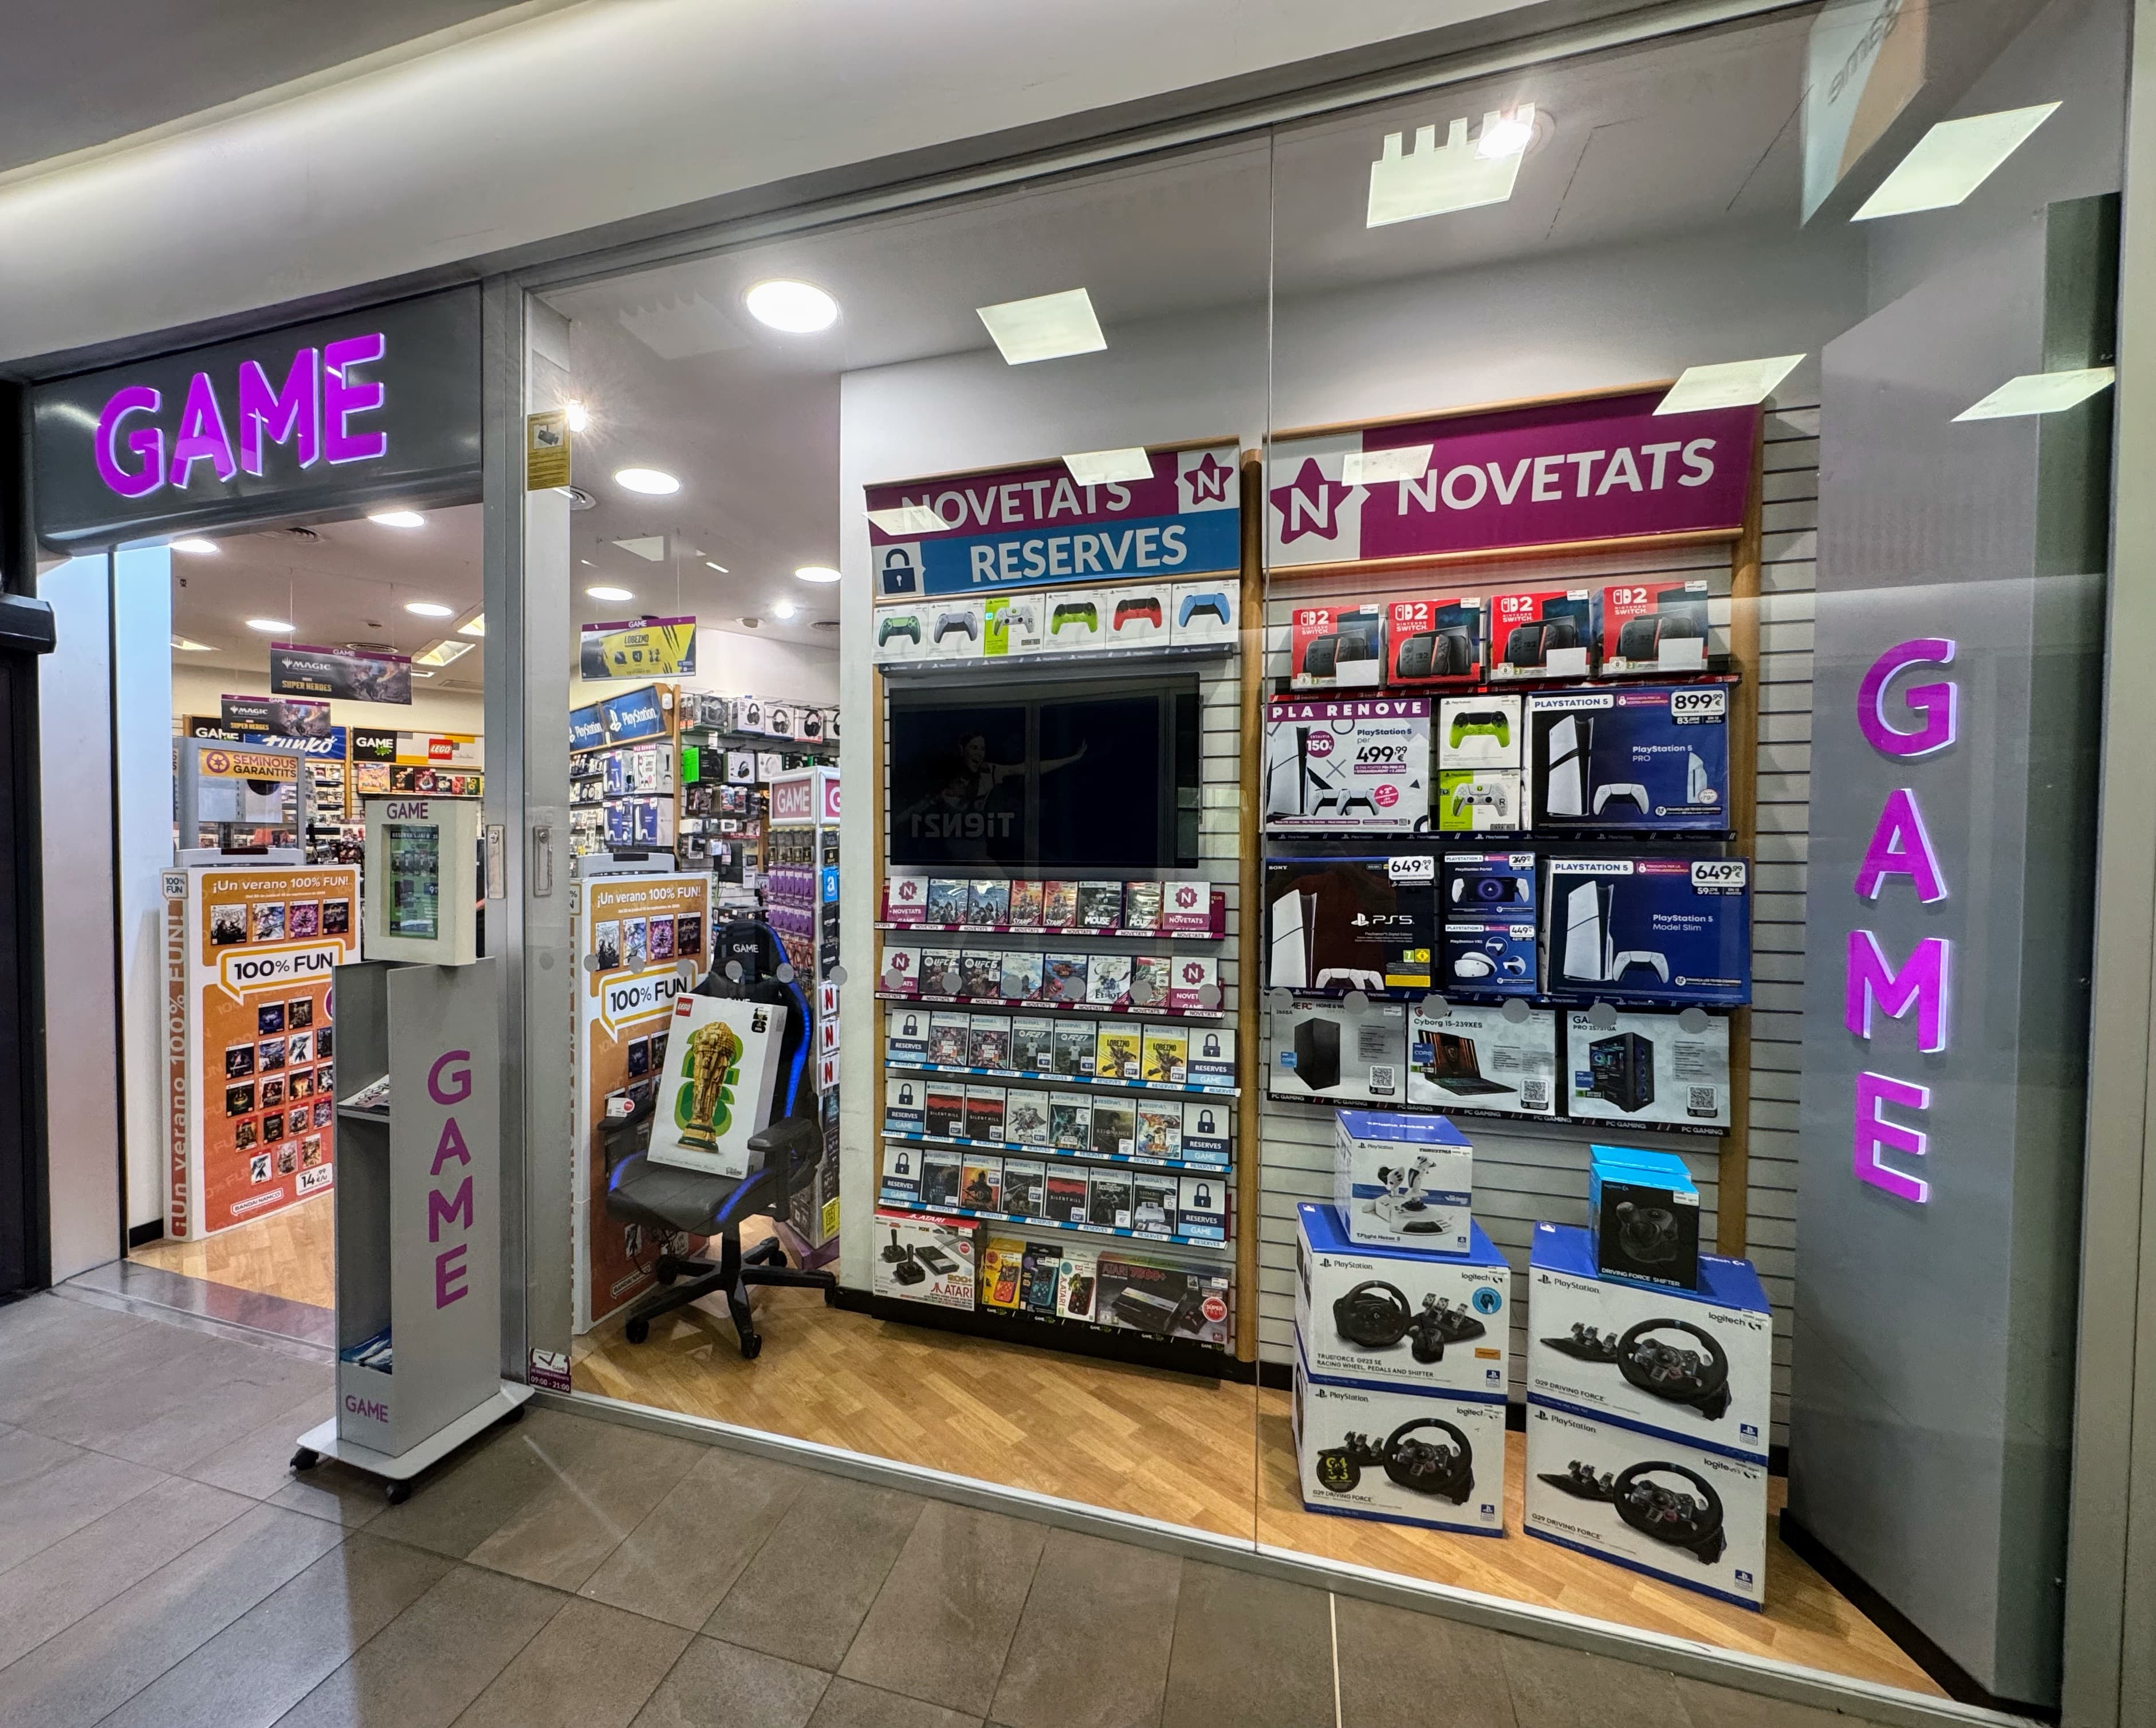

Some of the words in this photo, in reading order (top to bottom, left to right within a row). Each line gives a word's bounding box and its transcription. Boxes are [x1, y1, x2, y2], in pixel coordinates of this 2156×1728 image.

[95, 332, 387, 498] GAME
[1396, 438, 1717, 516] NOVETATS
[1198, 468, 1220, 500] N
[902, 471, 1132, 531] NOVETATS
[1290, 484, 1329, 532] N
[970, 525, 1187, 583] RESERVES
[1633, 588, 1648, 603] 2
[1519, 596, 1534, 612] 2
[1414, 603, 1428, 620] 2
[1614, 607, 1648, 615] SWITCH
[628, 620, 647, 628] GAME
[1317, 611, 1329, 625] 2
[1502, 615, 1533, 623] SWITCH
[1396, 625, 1429, 633] SWITCH
[624, 634, 650, 644] LOBEZNO
[333, 649, 355, 657] GAME
[293, 661, 331, 670] MAGIC
[282, 680, 305, 690] SUPER
[306, 682, 333, 693] HEROES
[1272, 705, 1313, 718] PLA
[1327, 701, 1422, 717] RENOVE
[1535, 698, 1601, 709] PLAYSTATION
[238, 707, 268, 715] MAGIC
[621, 708, 656, 727] PlayStation
[575, 722, 603, 740] PlayStation
[1357, 728, 1406, 736] PlayStation
[356, 737, 394, 748] GAME
[430, 745, 451, 753] LEGO
[1632, 745, 1685, 753] PlayStation
[233, 755, 297, 768] SEMINOUS
[233, 765, 297, 778] GARANTITS
[777, 786, 810, 814] GAME
[387, 803, 428, 819] GAME
[1555, 863, 1621, 871] PLAYSTATION
[165, 877, 185, 886] 100%
[213, 880, 238, 894] ¡Un
[242, 881, 287, 891] verano
[290, 877, 321, 888] 100%
[324, 876, 349, 886] FUN!
[166, 886, 183, 894] FUN
[903, 886, 912, 897] N
[597, 892, 614, 908] ¡Un
[616, 892, 647, 904] verano
[649, 889, 675, 900] 100%
[677, 886, 701, 898] FUN!
[1085, 916, 1111, 925] MOUSE
[1373, 915, 1413, 924] PS5
[1845, 637, 1957, 1205] GAME
[1653, 923, 1680, 931] Model
[168, 915, 185, 982] FUN!
[733, 944, 759, 953] GAME
[234, 959, 290, 980] 100%
[294, 952, 333, 972] FUN
[611, 984, 652, 1012] 100%
[655, 976, 687, 1002] FUN
[678, 1002, 691, 1011] LEGO
[1414, 1018, 1443, 1028] Cyborg
[1445, 1020, 1483, 1028] 15-239XES
[169, 994, 185, 1066] 100%
[895, 1042, 922, 1050] RESERVES
[1107, 1039, 1130, 1047] LOBEZNO
[1153, 1043, 1177, 1051] LOBEZNO
[1195, 1065, 1227, 1073] RESERVES
[891, 1111, 918, 1119] RESERVES
[174, 1077, 186, 1172] verano
[1096, 1128, 1130, 1136] RESONANCE
[1694, 1128, 1724, 1136] GAMING
[1190, 1141, 1221, 1149] RESERVES
[427, 1049, 473, 1310] GAME
[888, 1180, 914, 1189] RESERVES
[172, 1181, 187, 1227] ¡Un
[235, 1201, 258, 1211] BANDAI
[258, 1192, 281, 1204] NAMCO
[1186, 1215, 1217, 1224] RESERVES
[1102, 1263, 1128, 1277] ATARI
[1333, 1260, 1374, 1270] PlayStation
[1461, 1273, 1491, 1282] logitech
[1602, 1268, 1627, 1278] DRIVING
[1628, 1272, 1650, 1282] FORCE
[1653, 1277, 1680, 1287] SHIFTER
[945, 1284, 973, 1298] ATARI
[1554, 1278, 1600, 1294] PlayStation
[1708, 1312, 1746, 1327] logitech
[1317, 1353, 1354, 1362] TRUEFORCE
[1317, 1360, 1341, 1368] RACING
[1367, 1365, 1391, 1373] PEDALS
[552, 1381, 570, 1391] 21:00
[1535, 1379, 1548, 1387] G29
[1549, 1382, 1579, 1396] DRIVING
[1580, 1391, 1604, 1402] FORCE
[1329, 1391, 1368, 1403] PlayStation
[345, 1395, 389, 1424] GAME
[1551, 1415, 1596, 1434] PlayStation
[1325, 1491, 1351, 1499] DRIVING
[1352, 1494, 1372, 1502] FORCE
[1532, 1513, 1545, 1522] G29
[1547, 1517, 1576, 1533] DRIVING
[1577, 1527, 1602, 1540] FORCE
